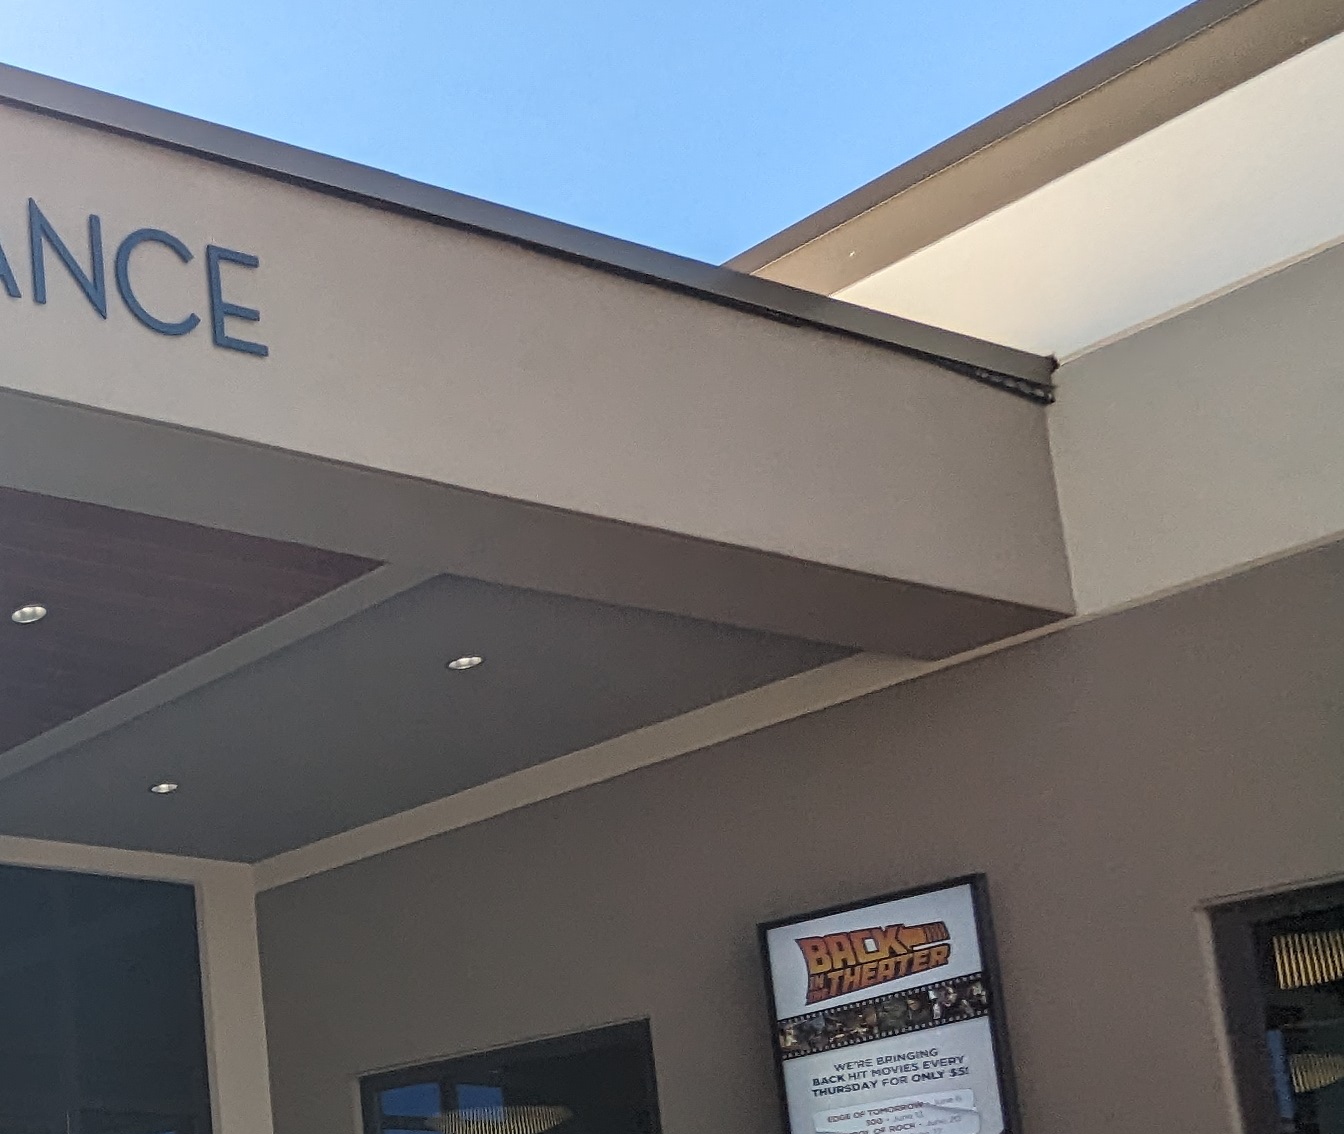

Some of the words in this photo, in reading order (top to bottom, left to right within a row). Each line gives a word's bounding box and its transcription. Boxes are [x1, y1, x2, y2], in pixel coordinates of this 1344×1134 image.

[795, 922, 912, 975] BACK
[827, 943, 952, 997] THEATER
[812, 1074, 846, 1087] BACK
[848, 1069, 868, 1082] HIT
[871, 1062, 919, 1078] MOVIES
[922, 1055, 965, 1070] EVERY
[833, 1057, 874, 1072] WE'RE
[876, 1048, 939, 1066] BRINGING
[811, 1079, 878, 1098] THURSDAY
[882, 1076, 909, 1087] FOR
[912, 1069, 945, 1083] ONLY
[867, 1101, 924, 1117] TOMORROW
